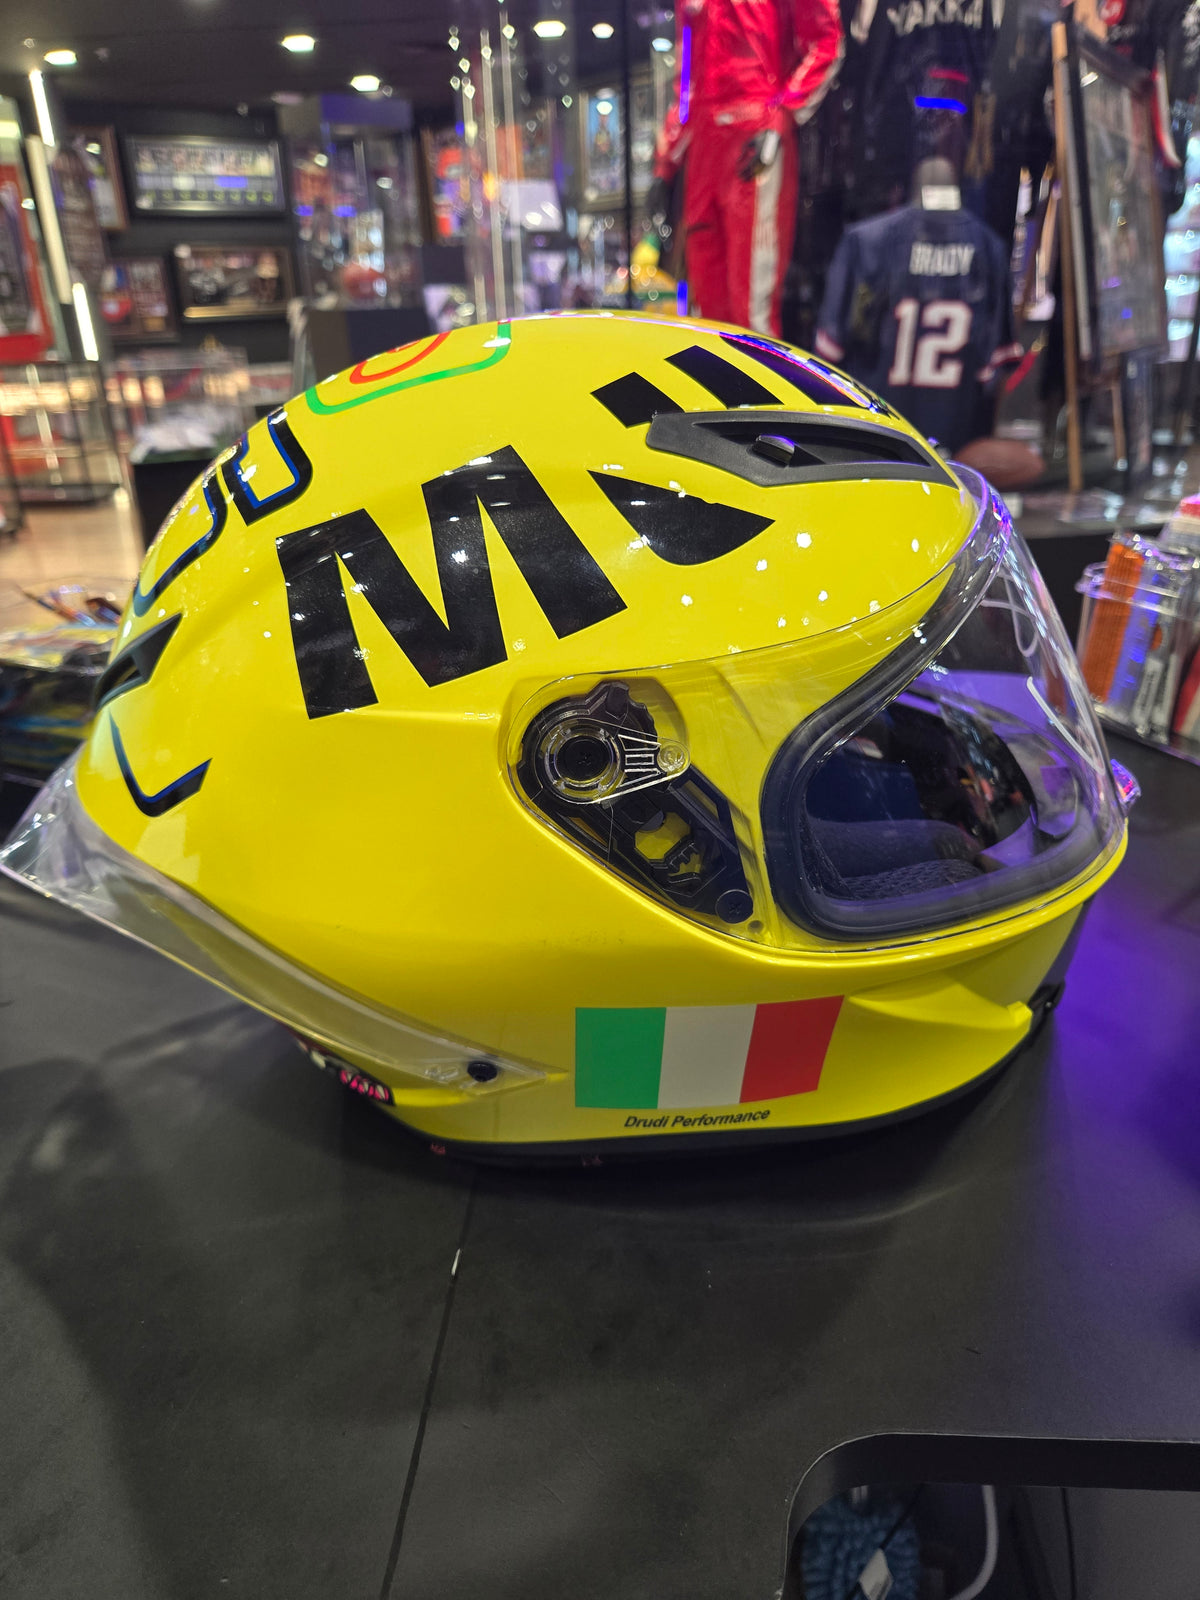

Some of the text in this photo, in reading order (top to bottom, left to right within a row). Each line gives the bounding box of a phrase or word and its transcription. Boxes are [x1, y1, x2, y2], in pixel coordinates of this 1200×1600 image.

[909, 242, 975, 276] BRADY
[888, 298, 972, 389] 12
[624, 1109, 771, 1128] Drudi Performance
